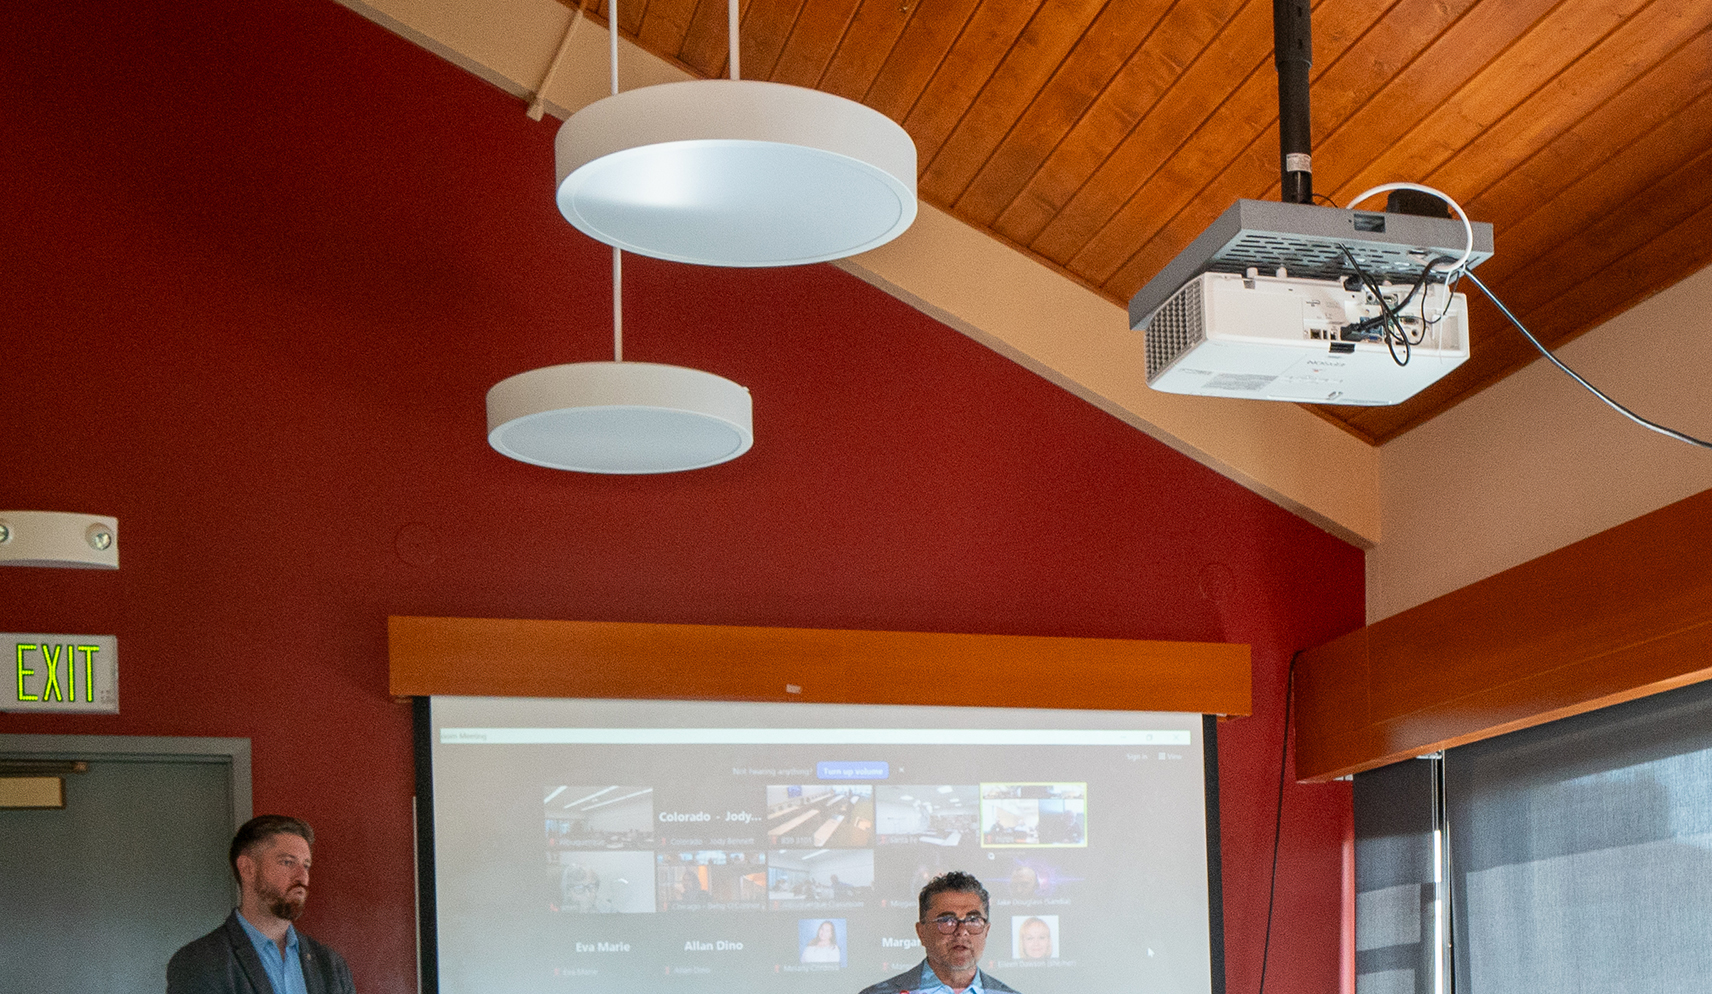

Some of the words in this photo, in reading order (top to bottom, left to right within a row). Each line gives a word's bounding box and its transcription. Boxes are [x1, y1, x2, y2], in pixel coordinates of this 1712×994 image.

[16, 643, 100, 702] EXIT
[732, 766, 747, 776] Not
[748, 766, 777, 778] hearing
[823, 766, 841, 776] Turn
[843, 768, 854, 778] up
[855, 766, 884, 776] volume
[658, 810, 712, 823] Colorado
[725, 809, 762, 824] Jody...
[669, 836, 703, 846] Colorado
[672, 902, 701, 912] Chicago
[575, 941, 596, 953] Eva
[597, 940, 631, 953] Marie
[684, 940, 714, 952] Allan
[716, 939, 744, 952] Dino
